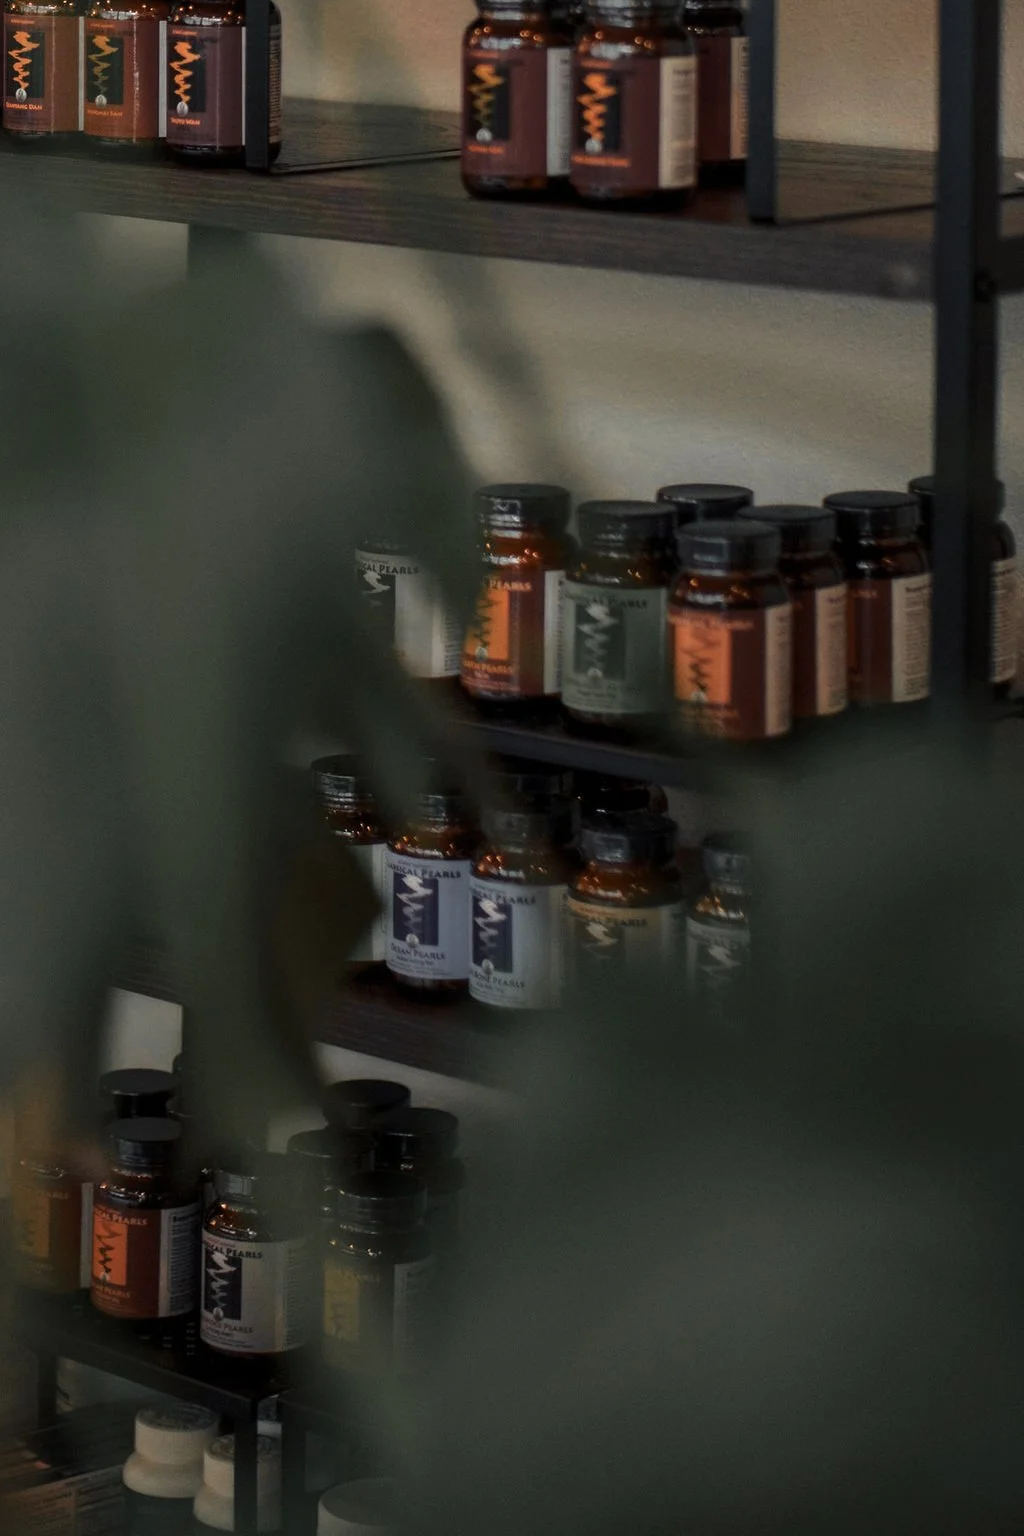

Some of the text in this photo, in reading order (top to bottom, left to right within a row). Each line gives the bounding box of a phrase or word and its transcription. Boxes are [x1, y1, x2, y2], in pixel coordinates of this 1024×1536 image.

[378, 564, 419, 575] PEARLS
[422, 867, 461, 879] PEARLS
[413, 948, 446, 961] PEARLS
[112, 1215, 148, 1226] PEARLS
[225, 1248, 263, 1260] PEARLS
